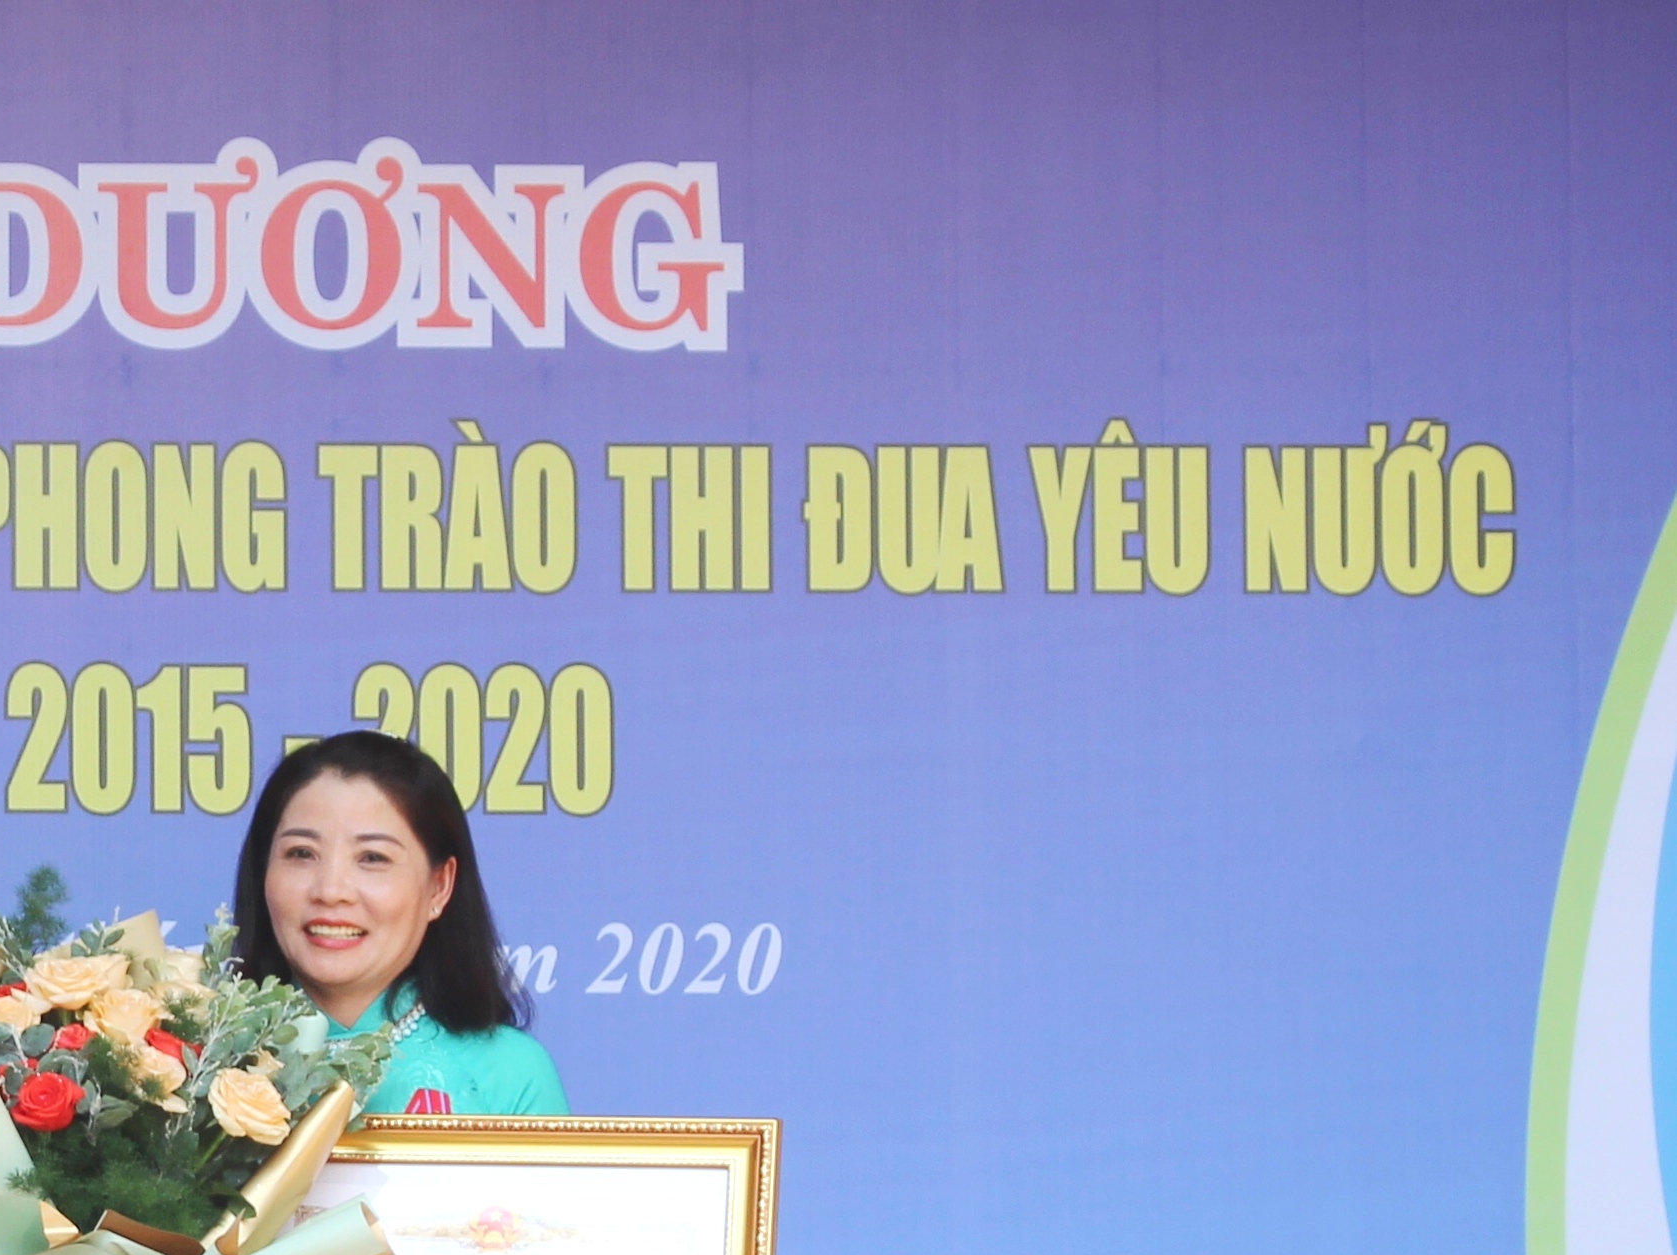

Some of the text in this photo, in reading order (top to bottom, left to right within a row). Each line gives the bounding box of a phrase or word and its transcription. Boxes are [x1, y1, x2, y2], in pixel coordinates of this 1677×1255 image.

[316, 418, 577, 594] TRÀO
[605, 442, 773, 594] THI
[801, 442, 1005, 594] ĐUA
[1027, 416, 1211, 596] YÊU
[1241, 416, 1517, 596] NƯỚC
[5, 660, 253, 816] 2015
[585, 921, 783, 997] 2020
